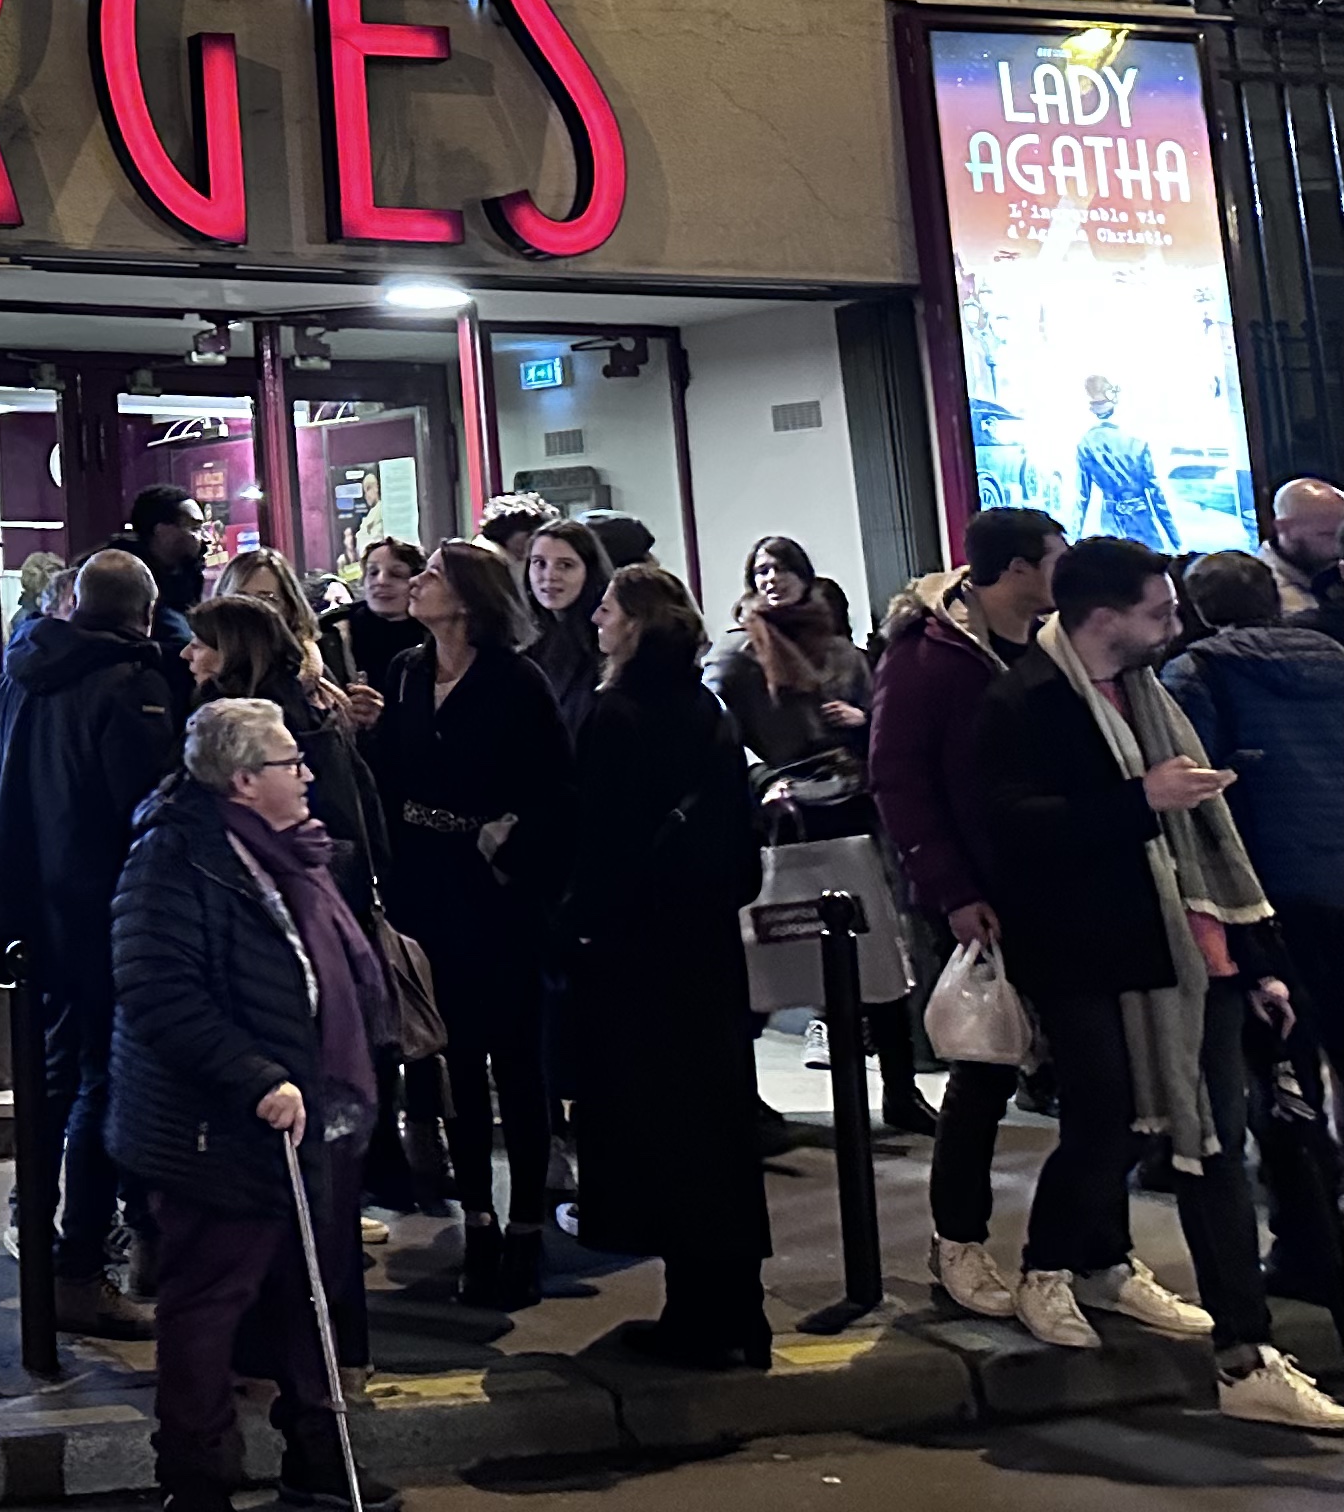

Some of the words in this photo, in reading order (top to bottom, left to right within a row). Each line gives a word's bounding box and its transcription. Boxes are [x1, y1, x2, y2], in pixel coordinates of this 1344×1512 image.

[997, 61, 1138, 128] LADY
[964, 131, 1191, 203] AGATHA
[1007, 220, 1087, 241] d'Aga
[1096, 227, 1173, 246] Christie
[1008, 199, 1129, 223] L'inyable
[1135, 208, 1166, 224] vie
